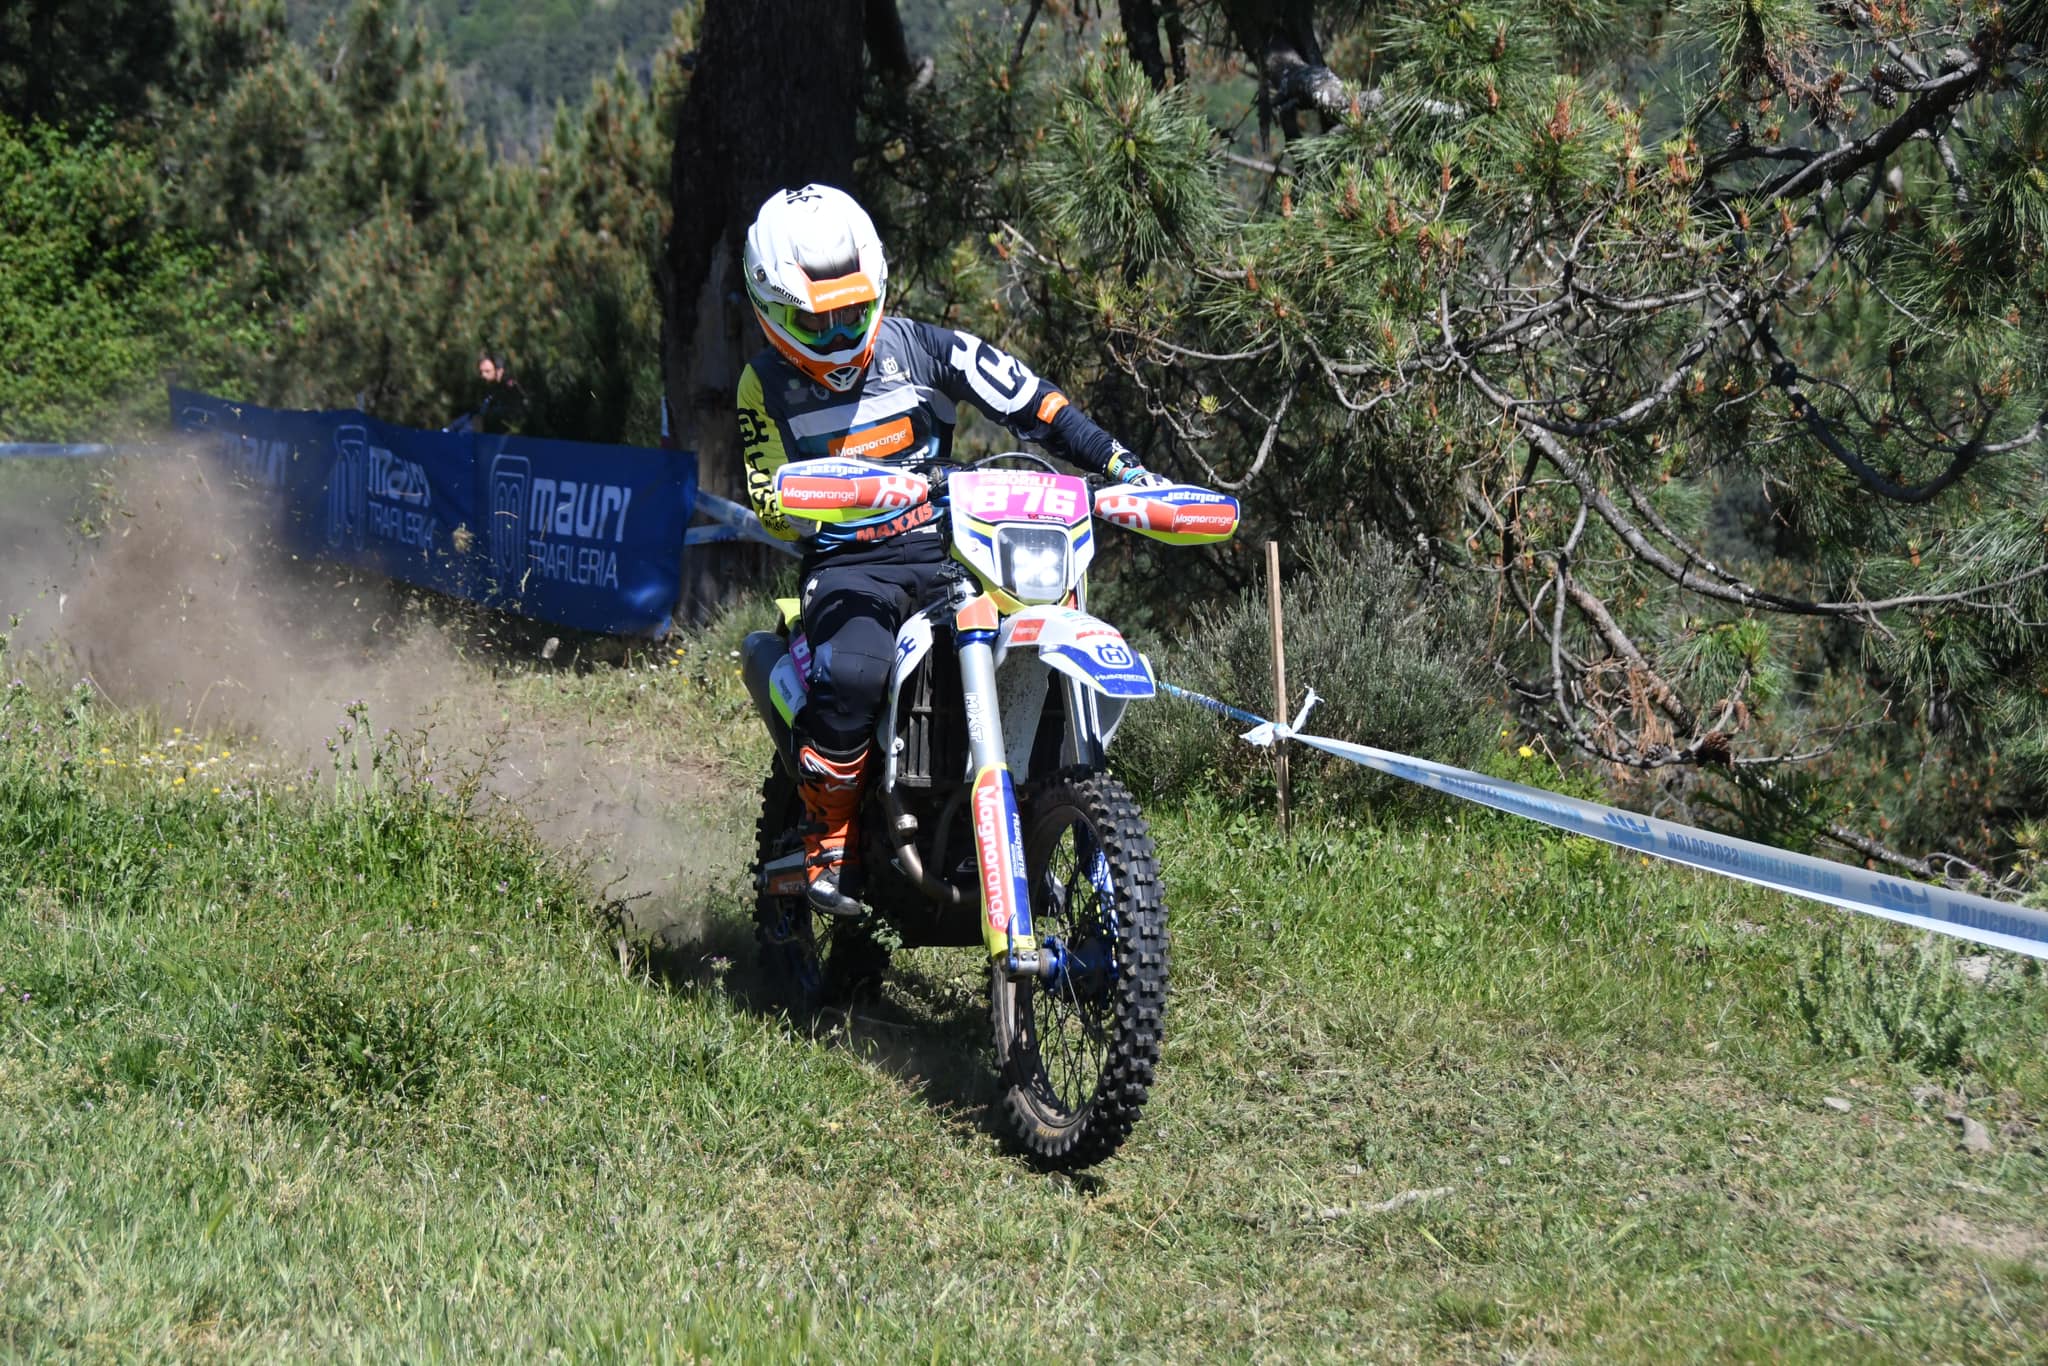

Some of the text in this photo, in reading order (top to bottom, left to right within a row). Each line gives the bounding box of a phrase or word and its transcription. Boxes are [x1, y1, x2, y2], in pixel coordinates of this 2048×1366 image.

[836, 429, 908, 457] Magnorange
[529, 477, 632, 543] mauri
[783, 487, 856, 502] Magnorange
[974, 485, 1077, 518] 876
[856, 501, 934, 543] MAXXIS
[1174, 513, 1234, 527] Magnorange
[528, 540, 620, 591] TRAFILERIA
[977, 785, 1007, 929] Magnorange
